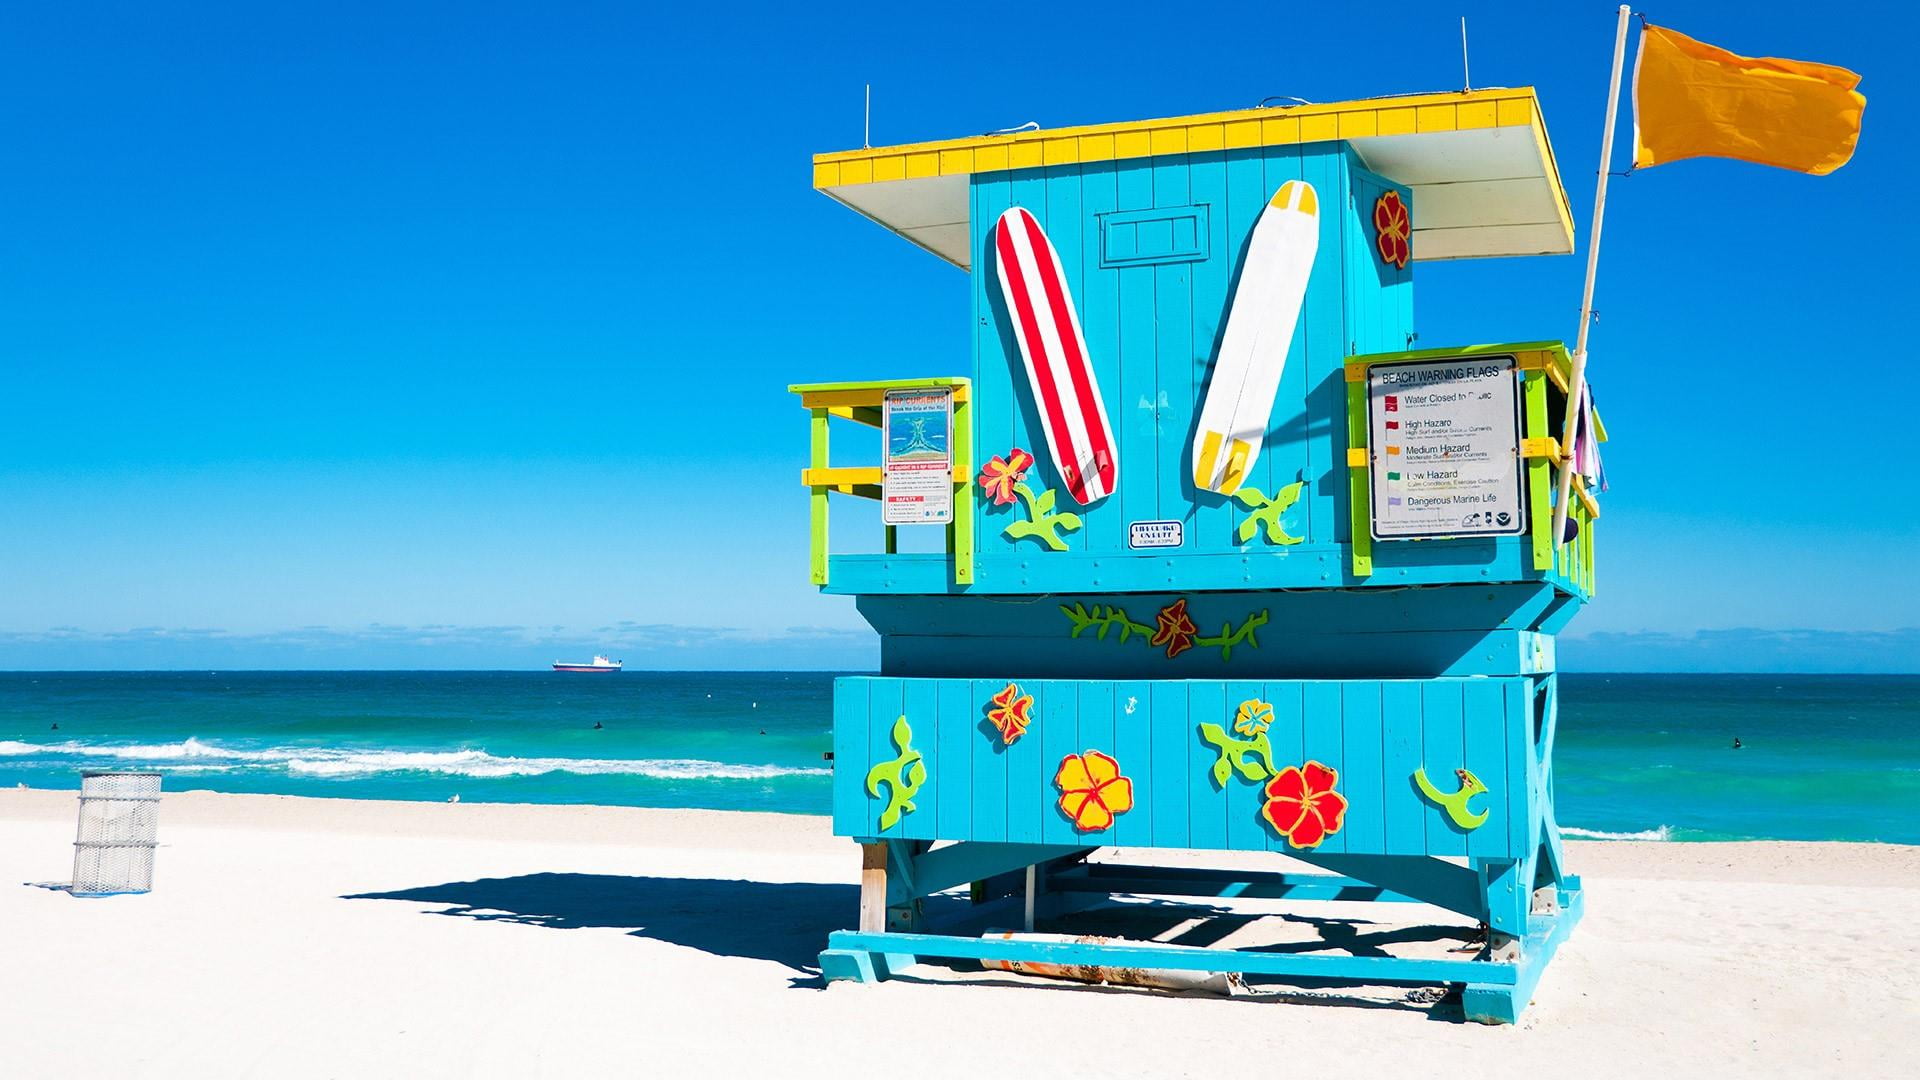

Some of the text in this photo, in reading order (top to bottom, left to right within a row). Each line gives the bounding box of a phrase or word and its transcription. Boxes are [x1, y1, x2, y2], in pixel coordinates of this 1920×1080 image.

[1382, 366, 1499, 384] BEACH WARNING FLAGS
[1404, 395, 1428, 404] Water
[1429, 393, 1457, 403] Closed
[1458, 393, 1467, 401] to
[1405, 420, 1423, 431] High
[1405, 443, 1471, 455] Medium Hazard
[1426, 469, 1459, 479] Hazard
[1407, 492, 1498, 508] Dangerous Marine Life
